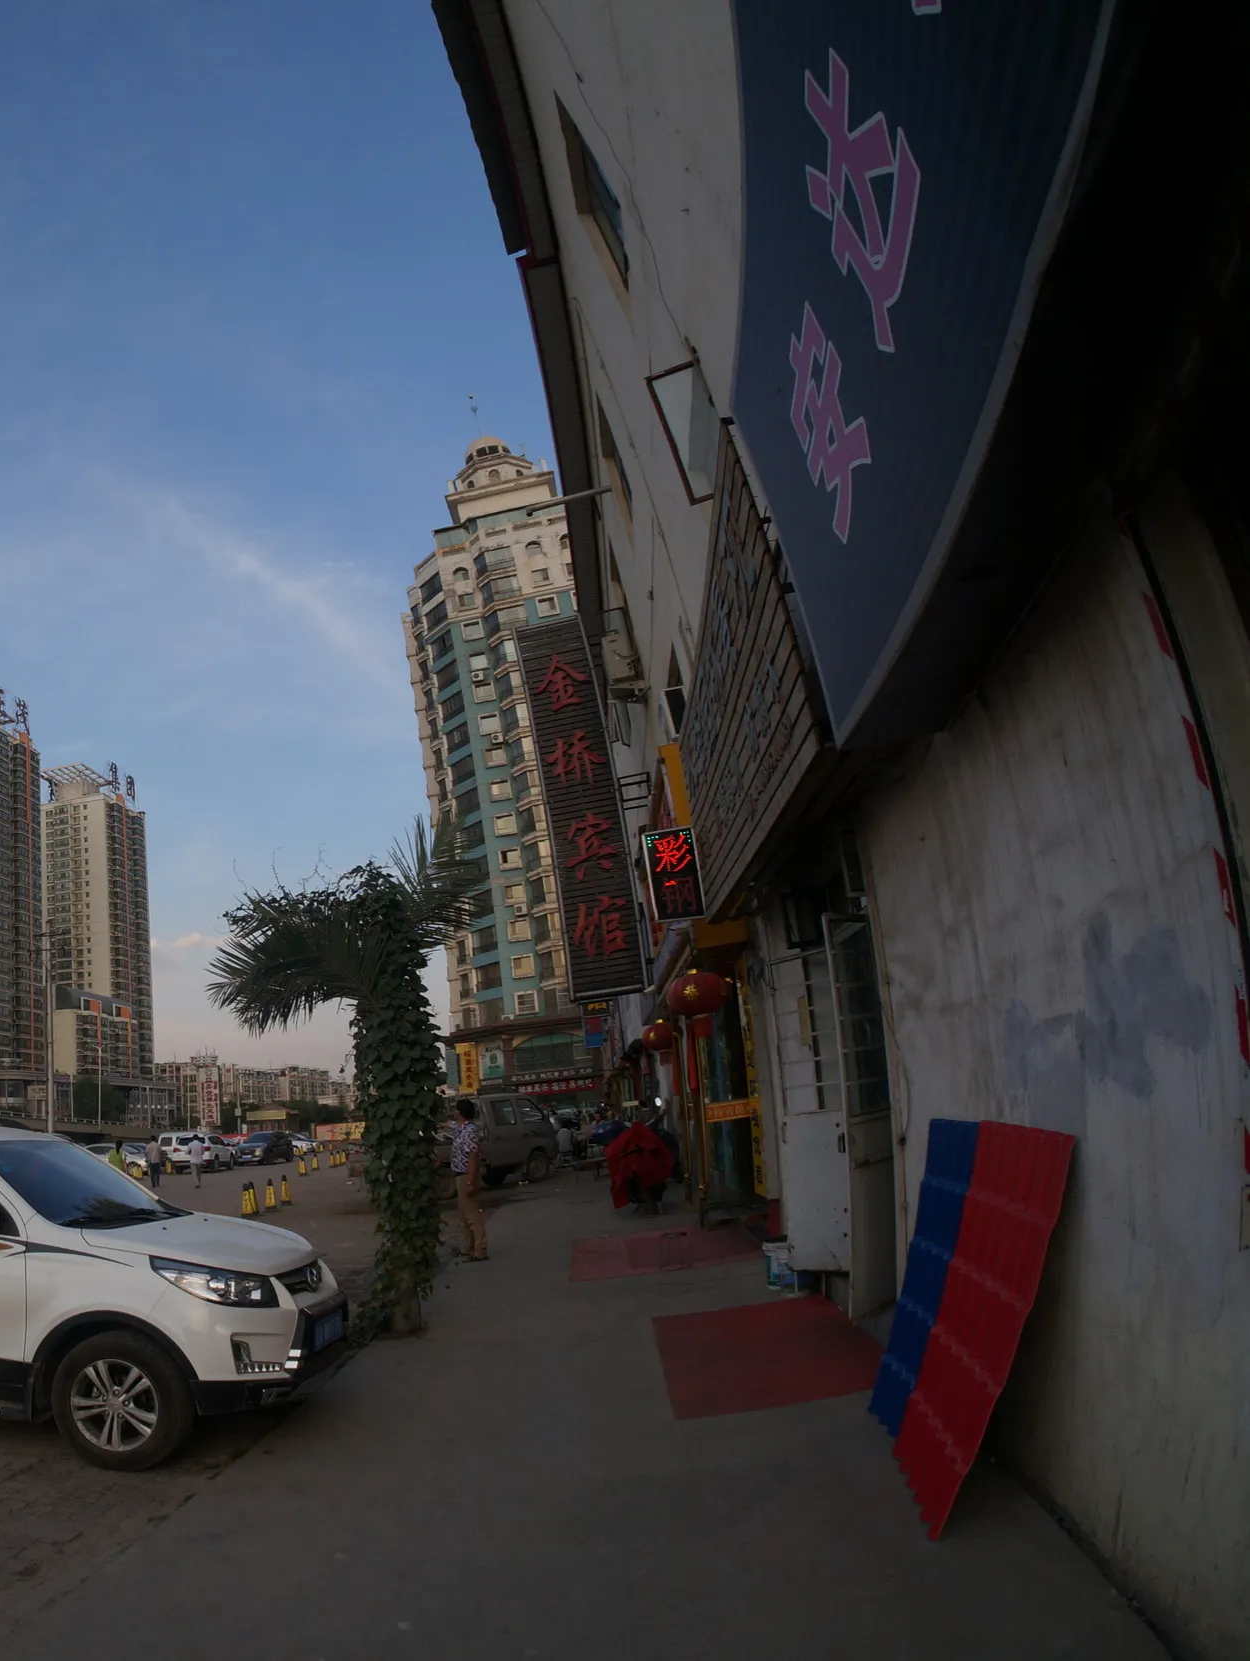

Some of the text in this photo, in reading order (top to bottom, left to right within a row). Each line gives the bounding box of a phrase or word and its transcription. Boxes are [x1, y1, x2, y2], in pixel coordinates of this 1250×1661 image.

[790, 0, 943, 544] 安达
[535, 655, 629, 959] 金桥宾馆
[652, 833, 699, 914] 彩钢
